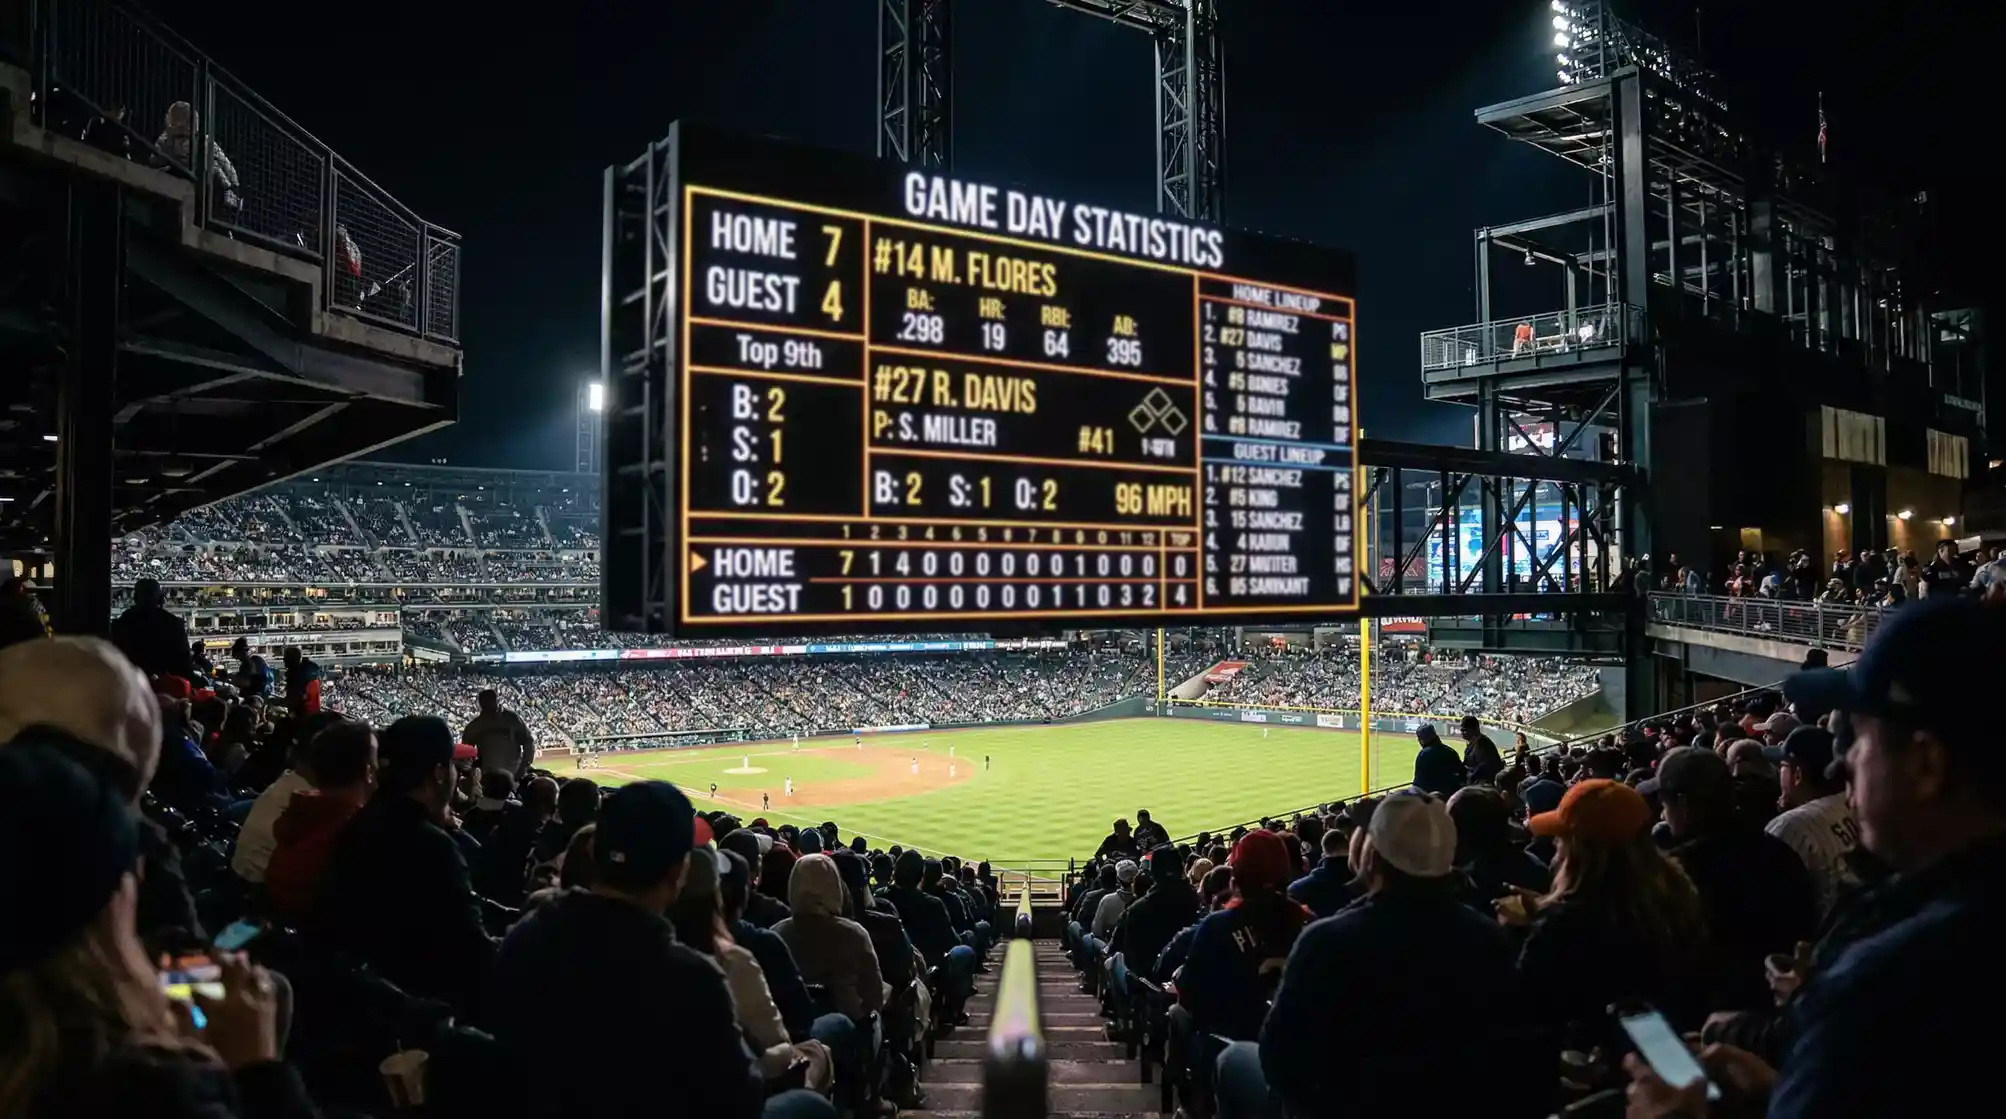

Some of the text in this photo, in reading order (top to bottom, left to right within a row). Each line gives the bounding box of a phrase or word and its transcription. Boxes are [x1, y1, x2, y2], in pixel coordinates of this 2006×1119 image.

[904, 173, 1223, 268] GAME DAY STATISTICS
[712, 211, 842, 266] HOME 7
[874, 238, 1057, 297] #14 M. FLORES
[707, 266, 843, 321] GUEST 4
[1233, 284, 1320, 312] HOME LINEUP
[907, 288, 1138, 336] BA: HR: RBI: AB:
[1205, 302, 1216, 320] 1.
[1247, 309, 1299, 333] RAMIREZ
[736, 334, 822, 369] Top 9th
[896, 313, 1142, 366] .298 19 64 395
[1204, 325, 1216, 342] 2.
[1247, 331, 1282, 352] DAVIS
[1204, 347, 1217, 365] 3.
[1247, 353, 1301, 376] SANCHEZ
[874, 366, 1036, 413] #27 R. DAVIS
[1205, 369, 1217, 387] 4.
[733, 384, 785, 421] B: 2
[1205, 391, 1217, 409] 5.
[874, 411, 996, 446] P: S. MILLER
[1078, 426, 1114, 454] #41
[1248, 417, 1300, 439] RAMIREZ
[733, 426, 781, 463] S: 1
[1234, 443, 1326, 464] GUEST LINEUP
[732, 469, 784, 505] O: 2
[1207, 465, 1218, 482] 1.
[1221, 466, 1246, 484] #12
[1249, 467, 1302, 487] SANCHEZ
[874, 471, 1191, 516] B: 2 S: 1 O: 2 96 MPH
[1206, 487, 1218, 505] 2.
[1249, 489, 1278, 507] KING
[1206, 510, 1219, 528] 3.
[1231, 511, 1246, 528] 15
[1249, 511, 1304, 530] SANCHEZ
[843, 525, 849, 539] 1
[871, 525, 880, 540] 2
[899, 525, 907, 540] 3
[925, 526, 934, 540] 4
[978, 527, 986, 542] 5
[1029, 529, 1037, 542] 7
[1120, 532, 1131, 544] 11
[1142, 532, 1154, 545] 12
[1206, 532, 1220, 550] 4.
[1237, 533, 1246, 550] 4
[714, 548, 1186, 577] HOME 7 1 4 0 0 0 0 0 0 1 0 0 0 0
[1206, 554, 1218, 572] 5.
[1230, 555, 1246, 573] 27
[713, 584, 1186, 613] GUEST 1 0 0 0 0 0 0 0 1 1 0 3 2 4
[1206, 577, 1219, 595] 6.
